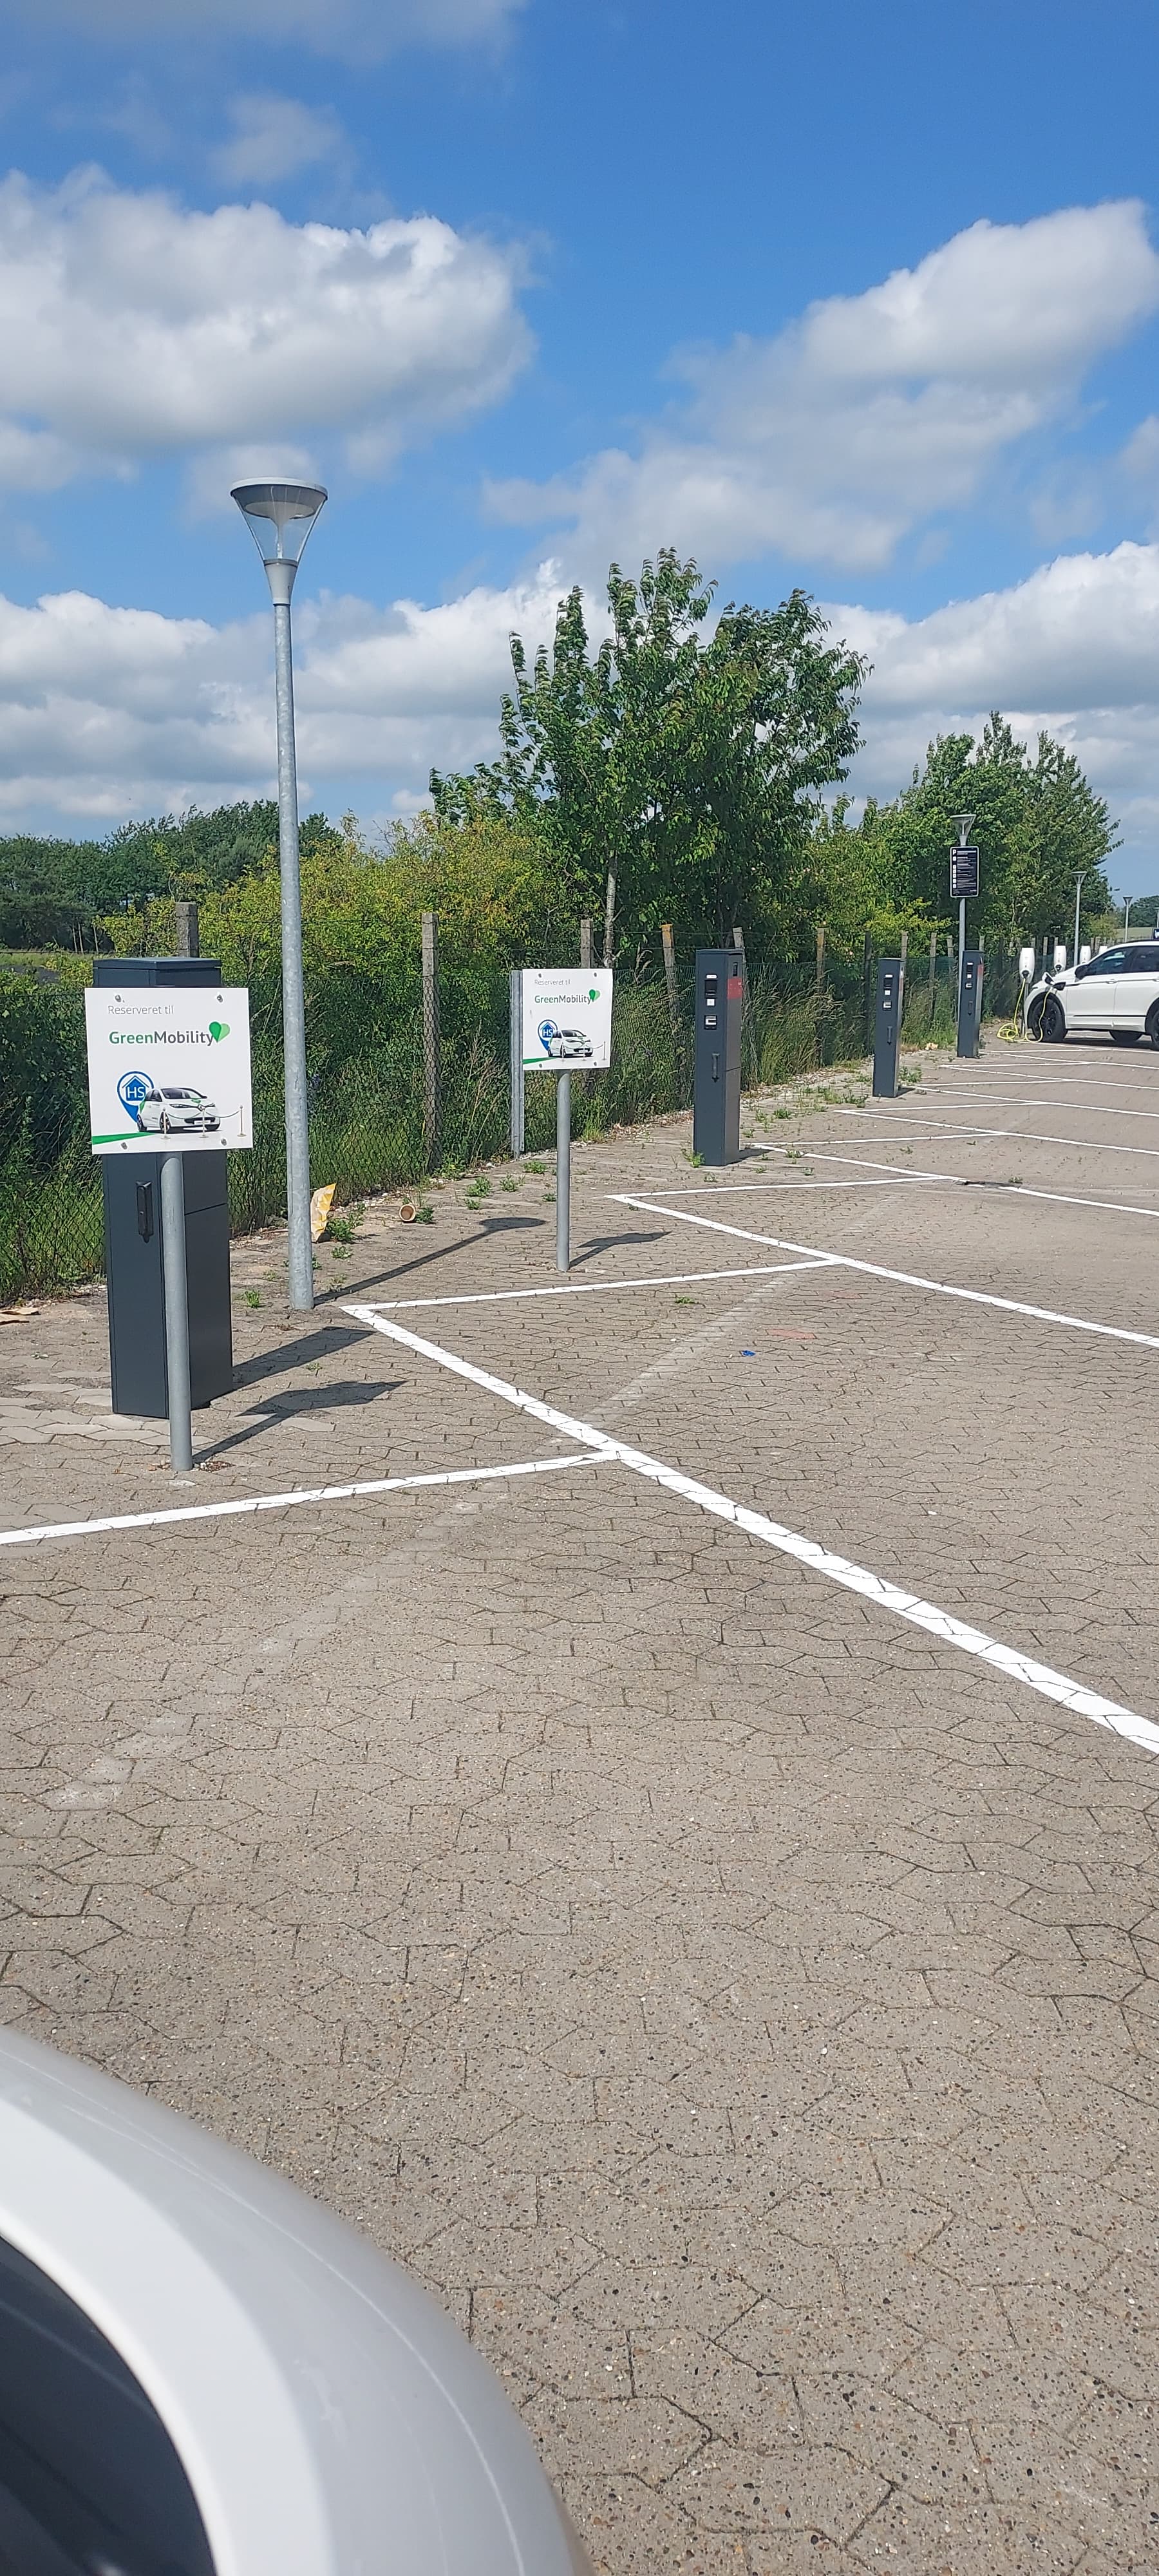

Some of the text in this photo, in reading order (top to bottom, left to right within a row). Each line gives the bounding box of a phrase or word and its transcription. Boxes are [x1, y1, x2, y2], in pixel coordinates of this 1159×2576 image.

[534, 994, 591, 1005] GreenMobility
[108, 1005, 174, 1015] Reserveret til
[109, 1030, 214, 1046] GreenMobility
[543, 1028, 553, 1037] HS
[127, 1086, 145, 1099] HS
